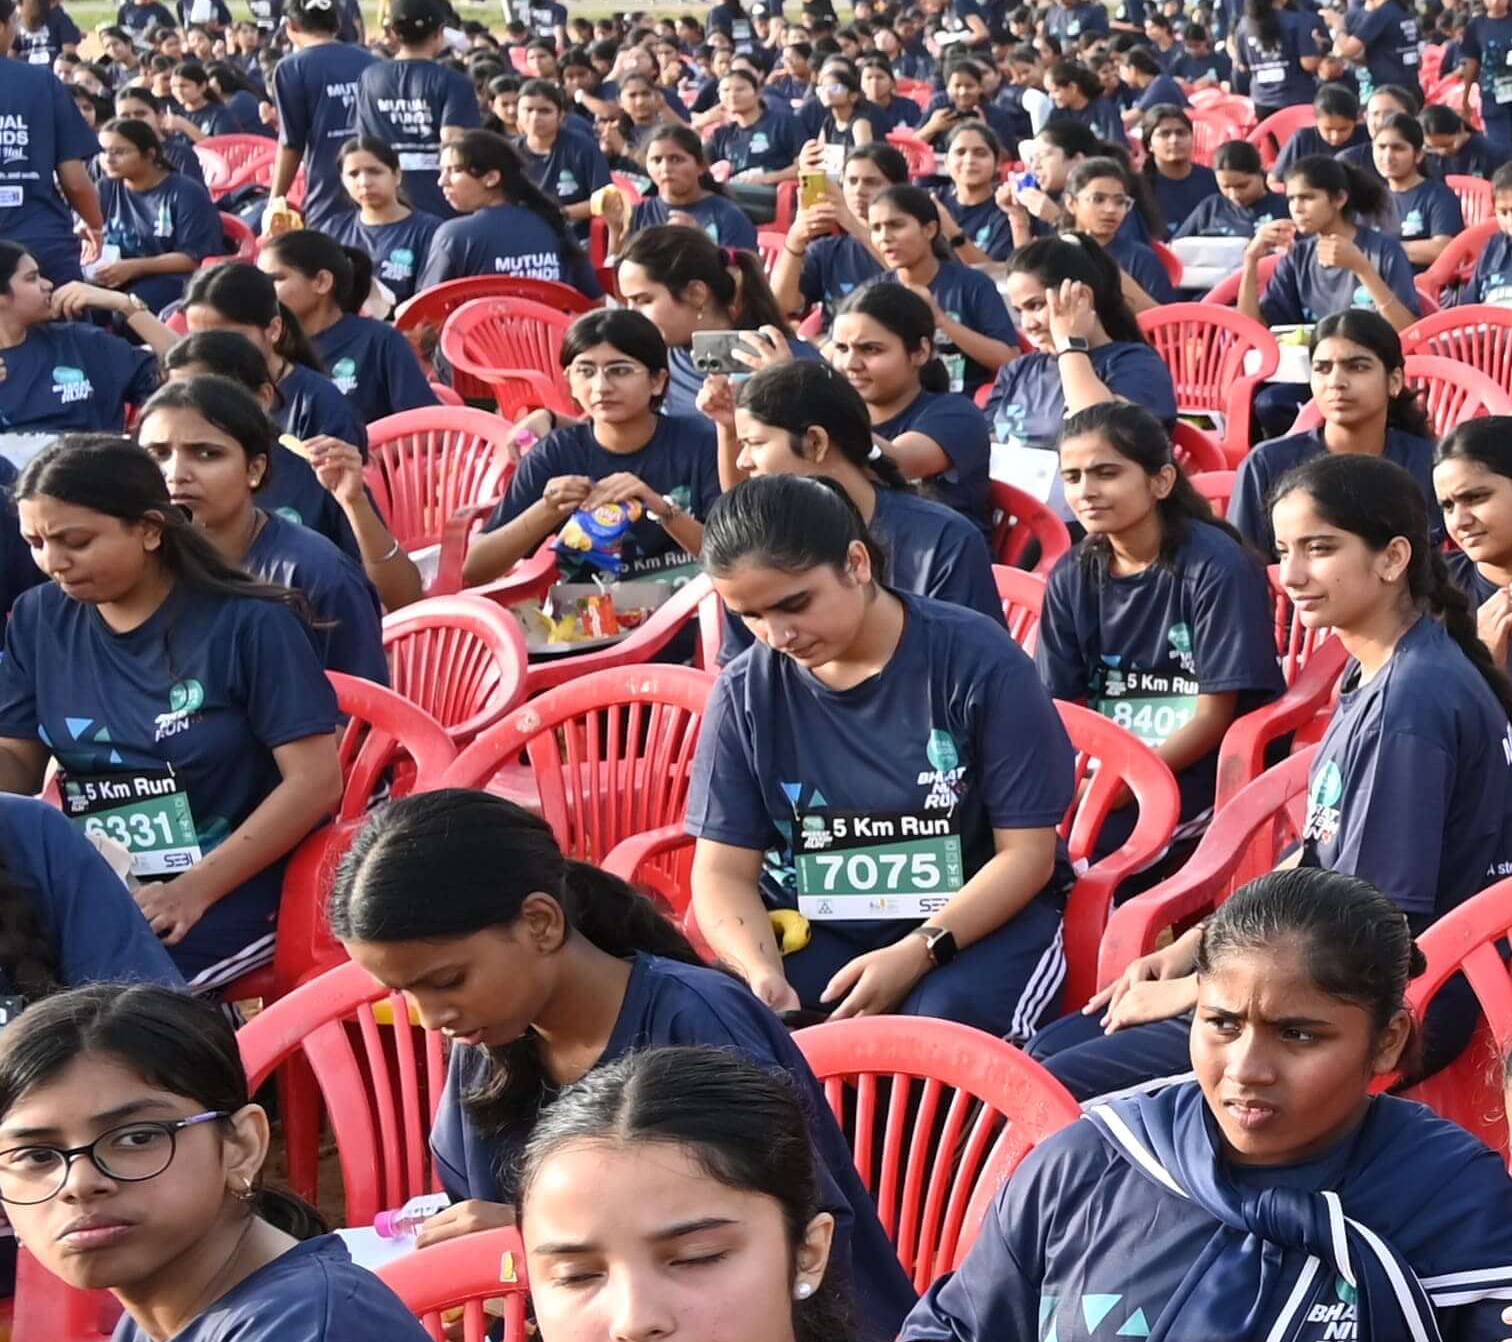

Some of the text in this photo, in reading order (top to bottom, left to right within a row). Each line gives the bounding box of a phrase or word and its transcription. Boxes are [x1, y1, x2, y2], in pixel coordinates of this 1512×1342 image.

[495, 252, 560, 272] MUTUAL
[1127, 673, 1168, 691] 5 Km
[86, 777, 176, 800] 5 Km Run
[84, 809, 175, 846] 6331
[834, 816, 951, 838] 5 Km Run
[815, 852, 941, 892] 7075
